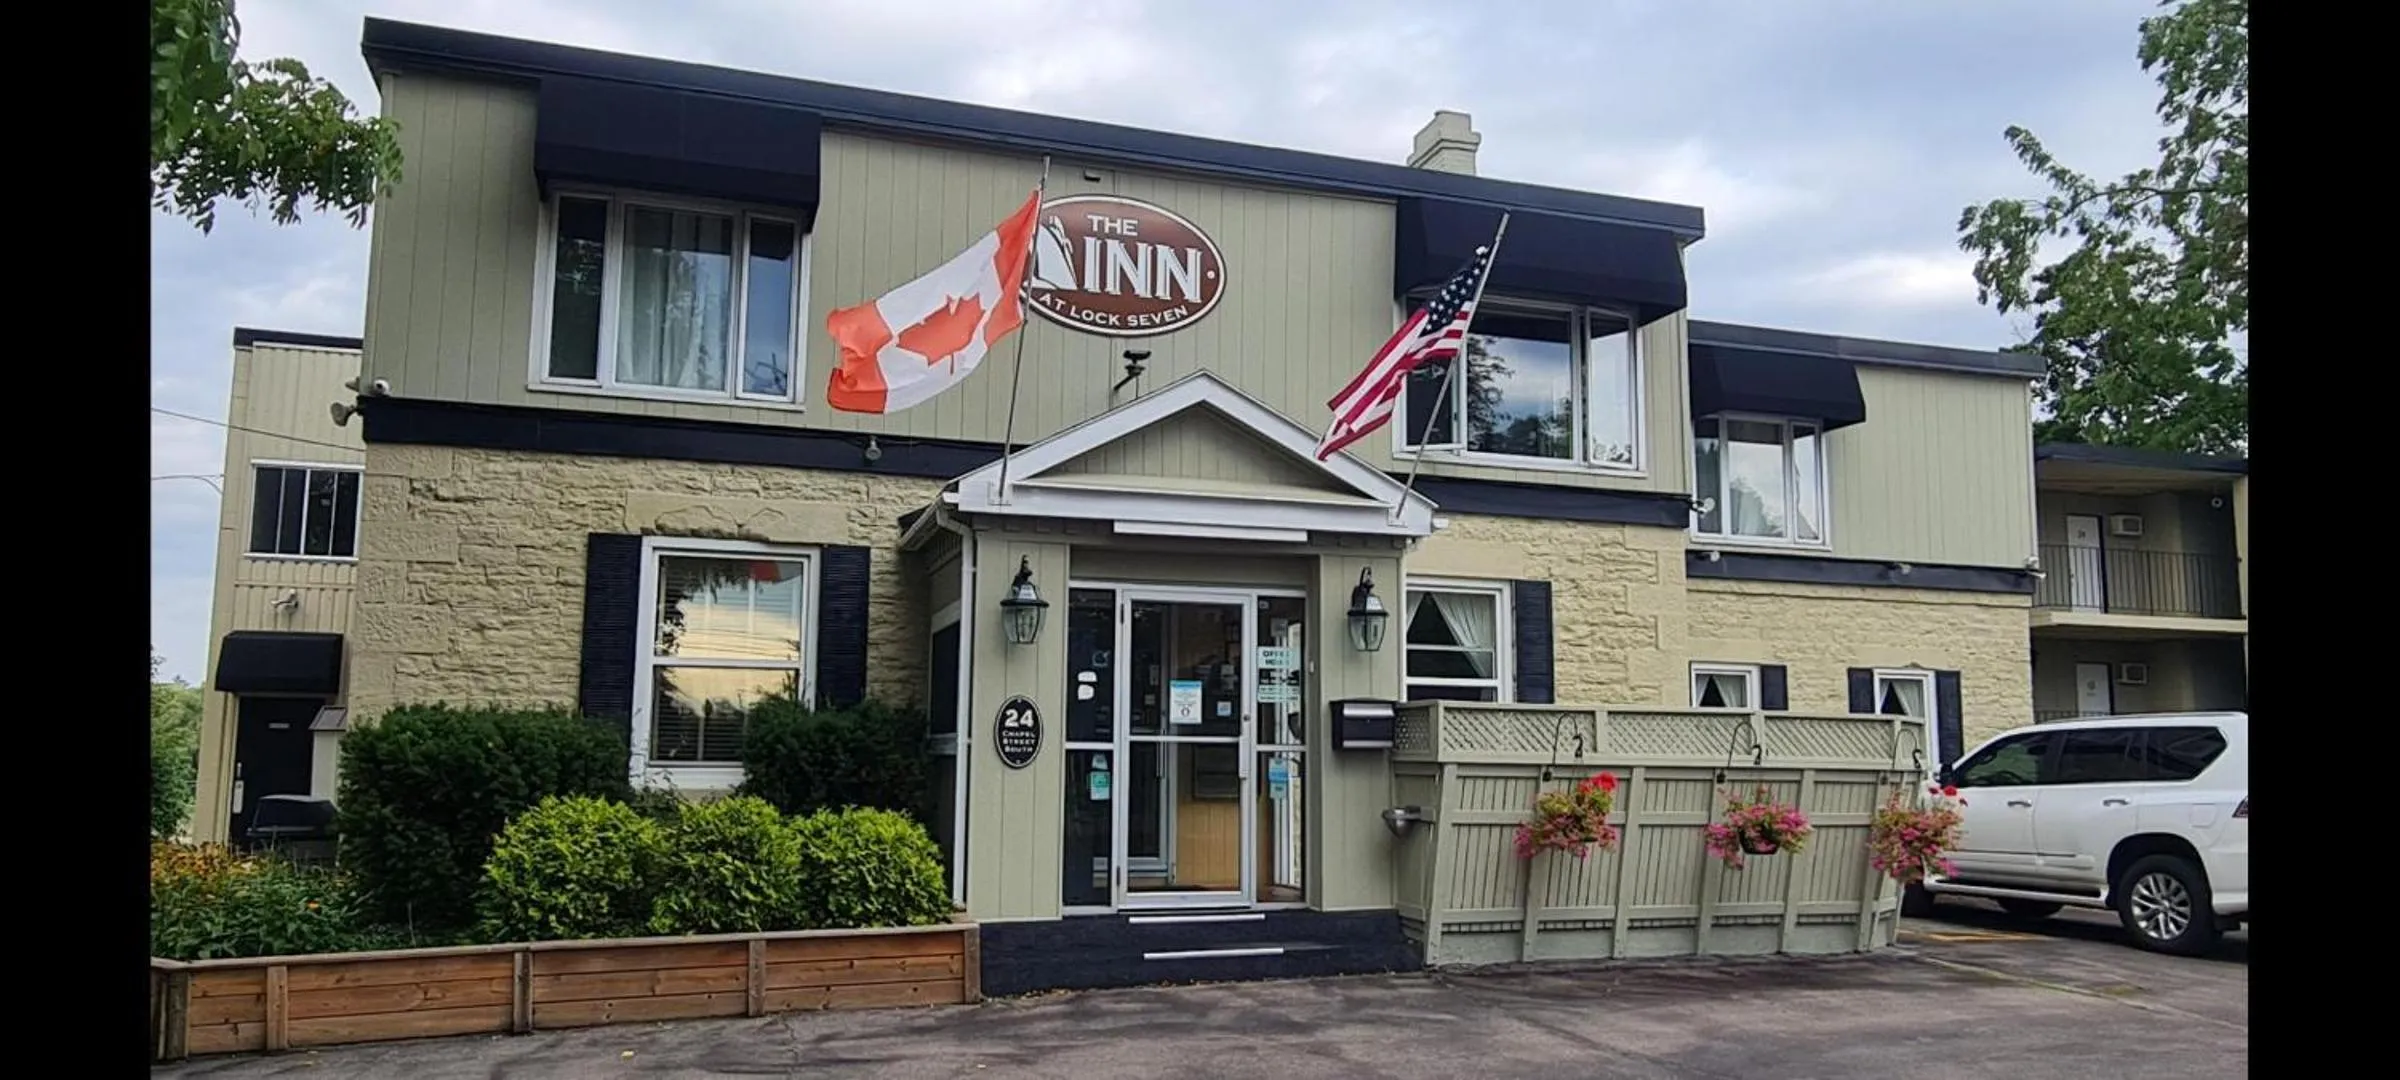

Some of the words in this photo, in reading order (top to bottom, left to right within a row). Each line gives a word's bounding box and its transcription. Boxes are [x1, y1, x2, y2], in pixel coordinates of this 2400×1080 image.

[1086, 214, 1139, 237] THE
[1082, 236, 1203, 304] INN
[1038, 292, 1067, 312] AT
[1069, 304, 1121, 326] LOCK
[1126, 304, 1190, 327] SEVEN
[1004, 708, 1035, 727] 24
